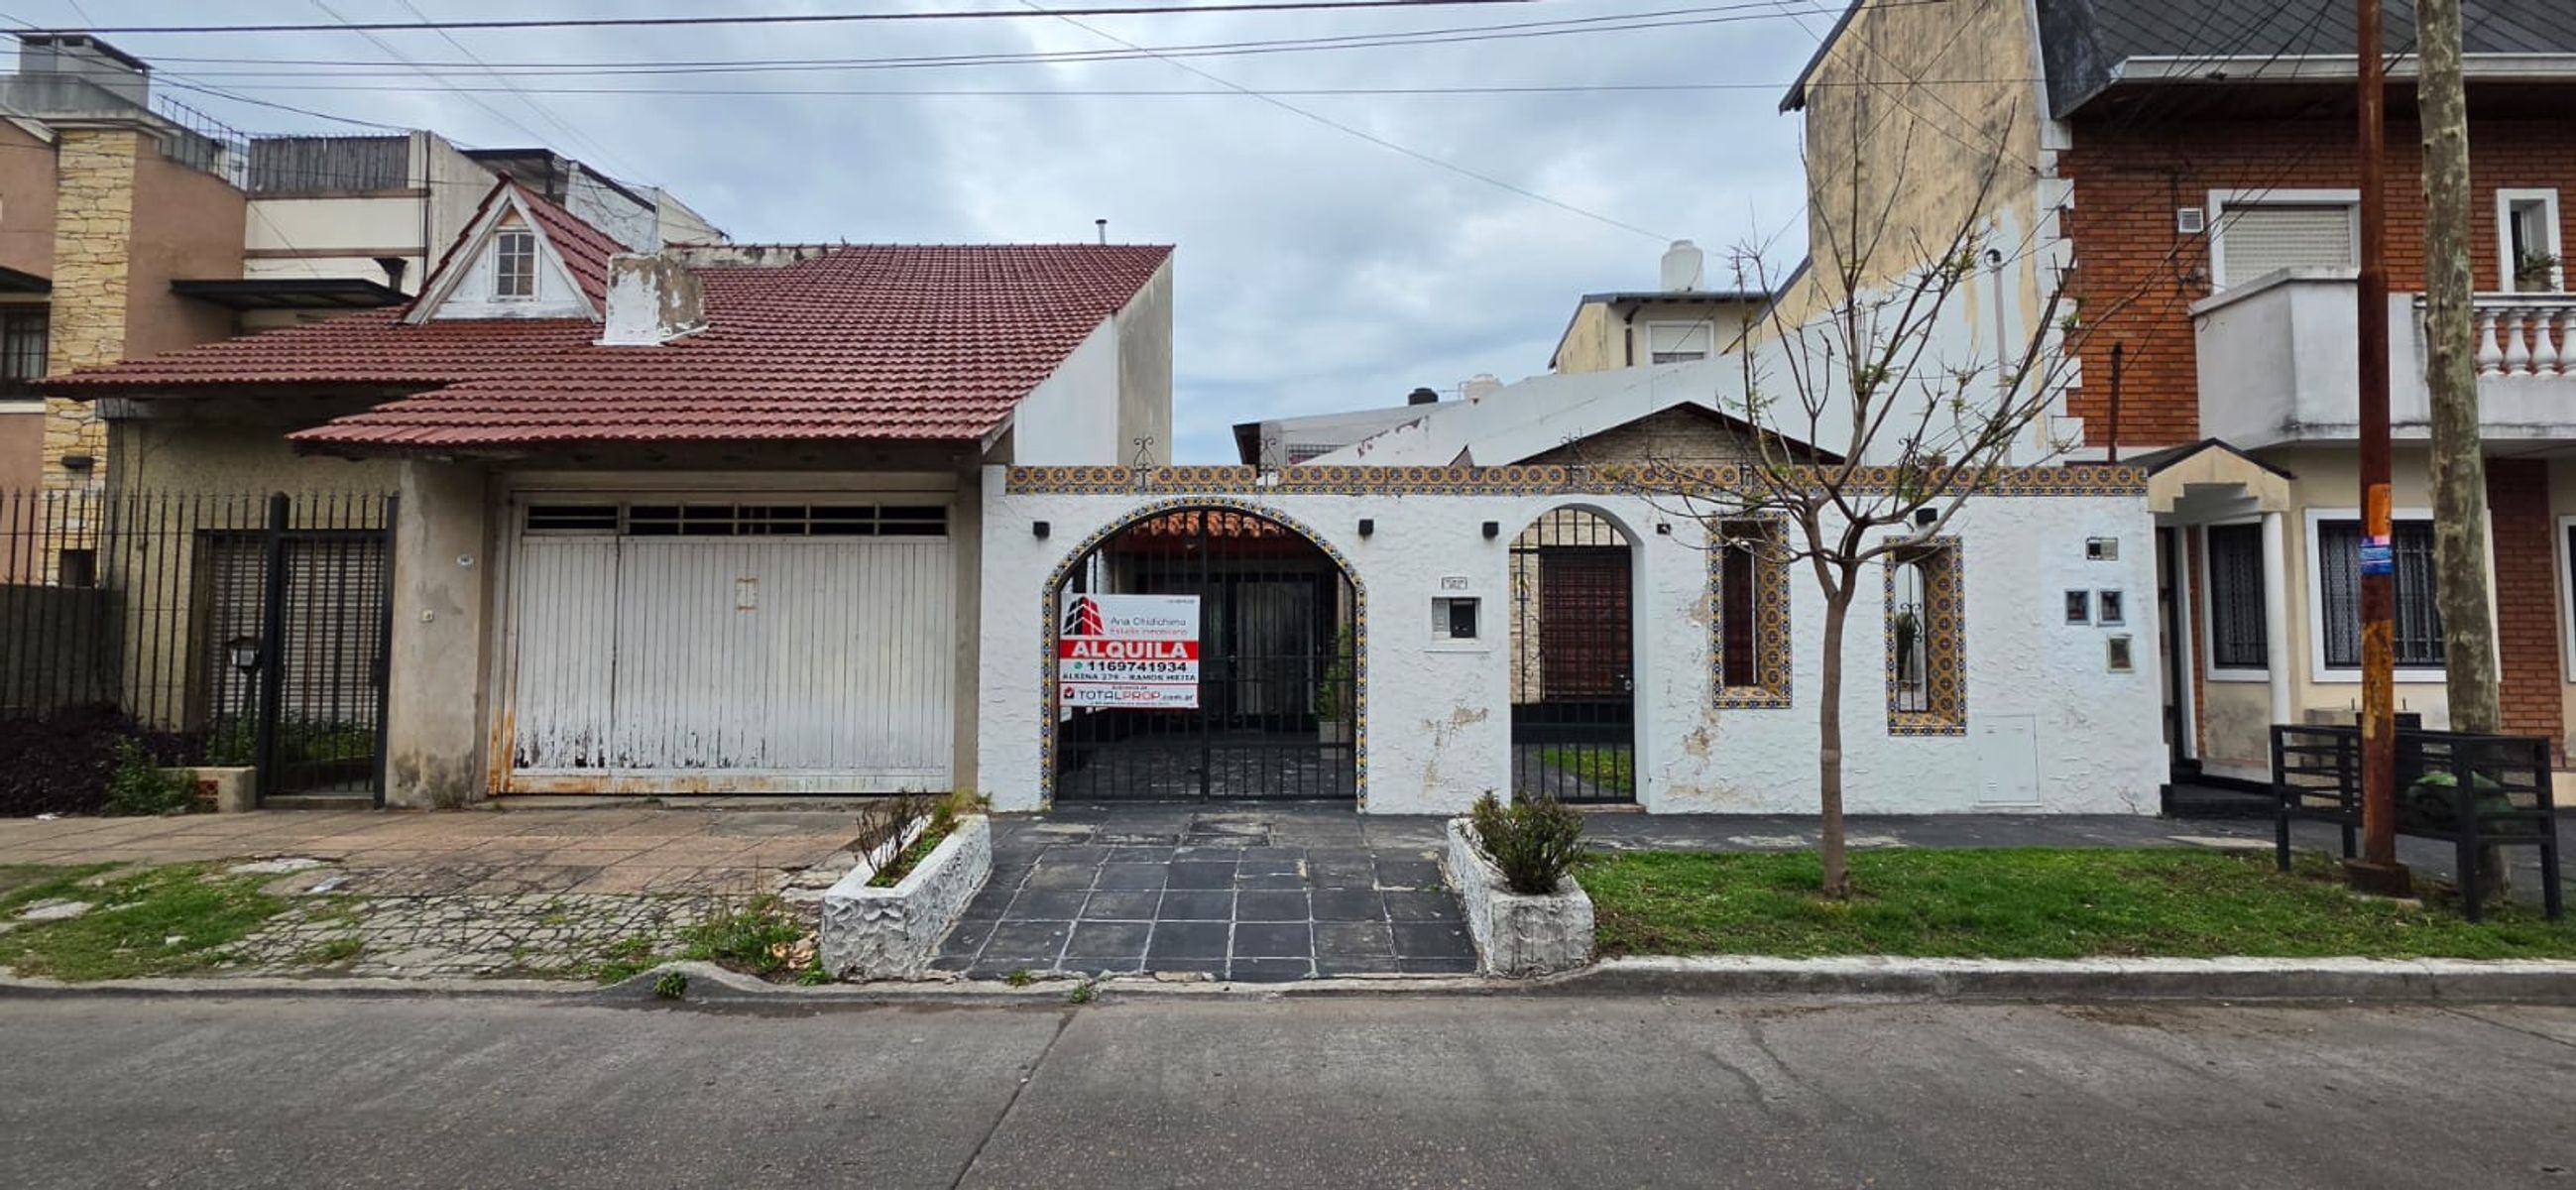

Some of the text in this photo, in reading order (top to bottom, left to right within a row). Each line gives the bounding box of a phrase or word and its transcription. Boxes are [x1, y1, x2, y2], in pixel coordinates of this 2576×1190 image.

[1111, 617, 1130, 626] Ana
[1071, 641, 1189, 658] ALQUILA
[1088, 661, 1186, 672] 1169741934
